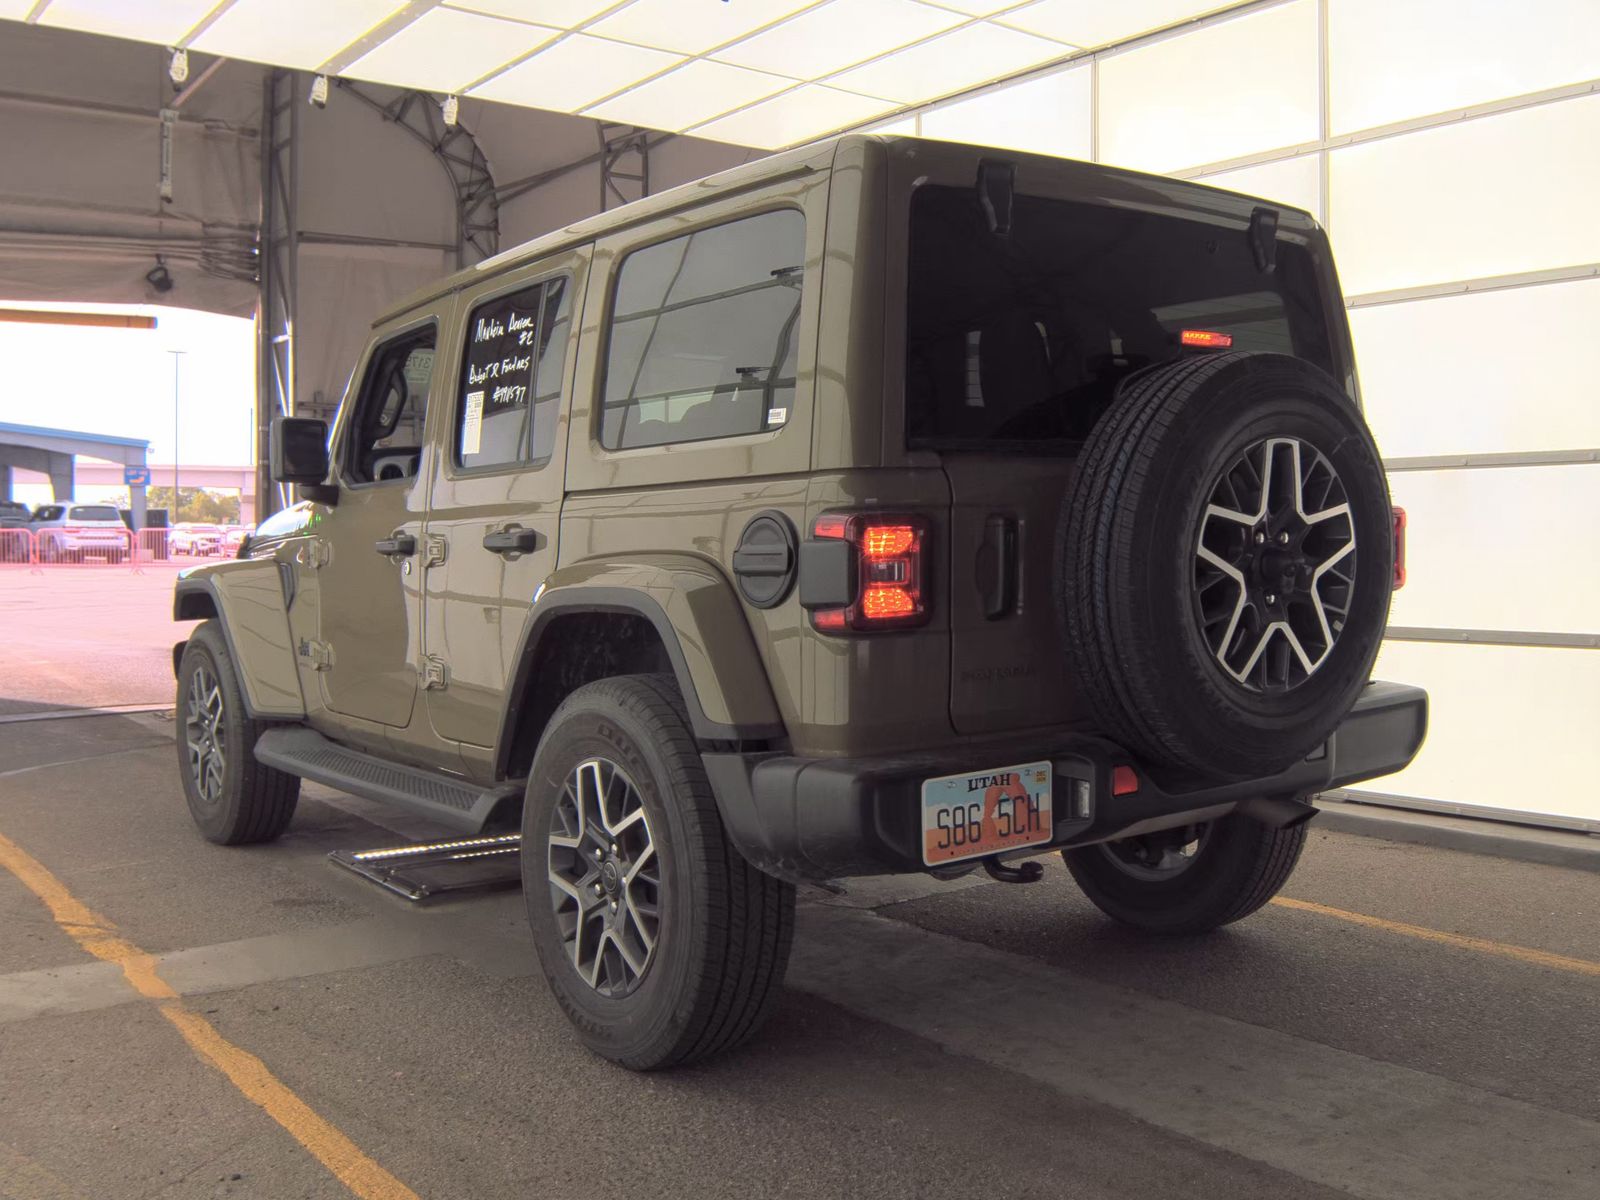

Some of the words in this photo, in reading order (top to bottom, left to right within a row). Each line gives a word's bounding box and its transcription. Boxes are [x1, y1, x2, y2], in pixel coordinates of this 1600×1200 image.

[967, 773, 1011, 792] UTAH
[937, 803, 981, 849] S86
[998, 792, 1040, 837] 5CH
